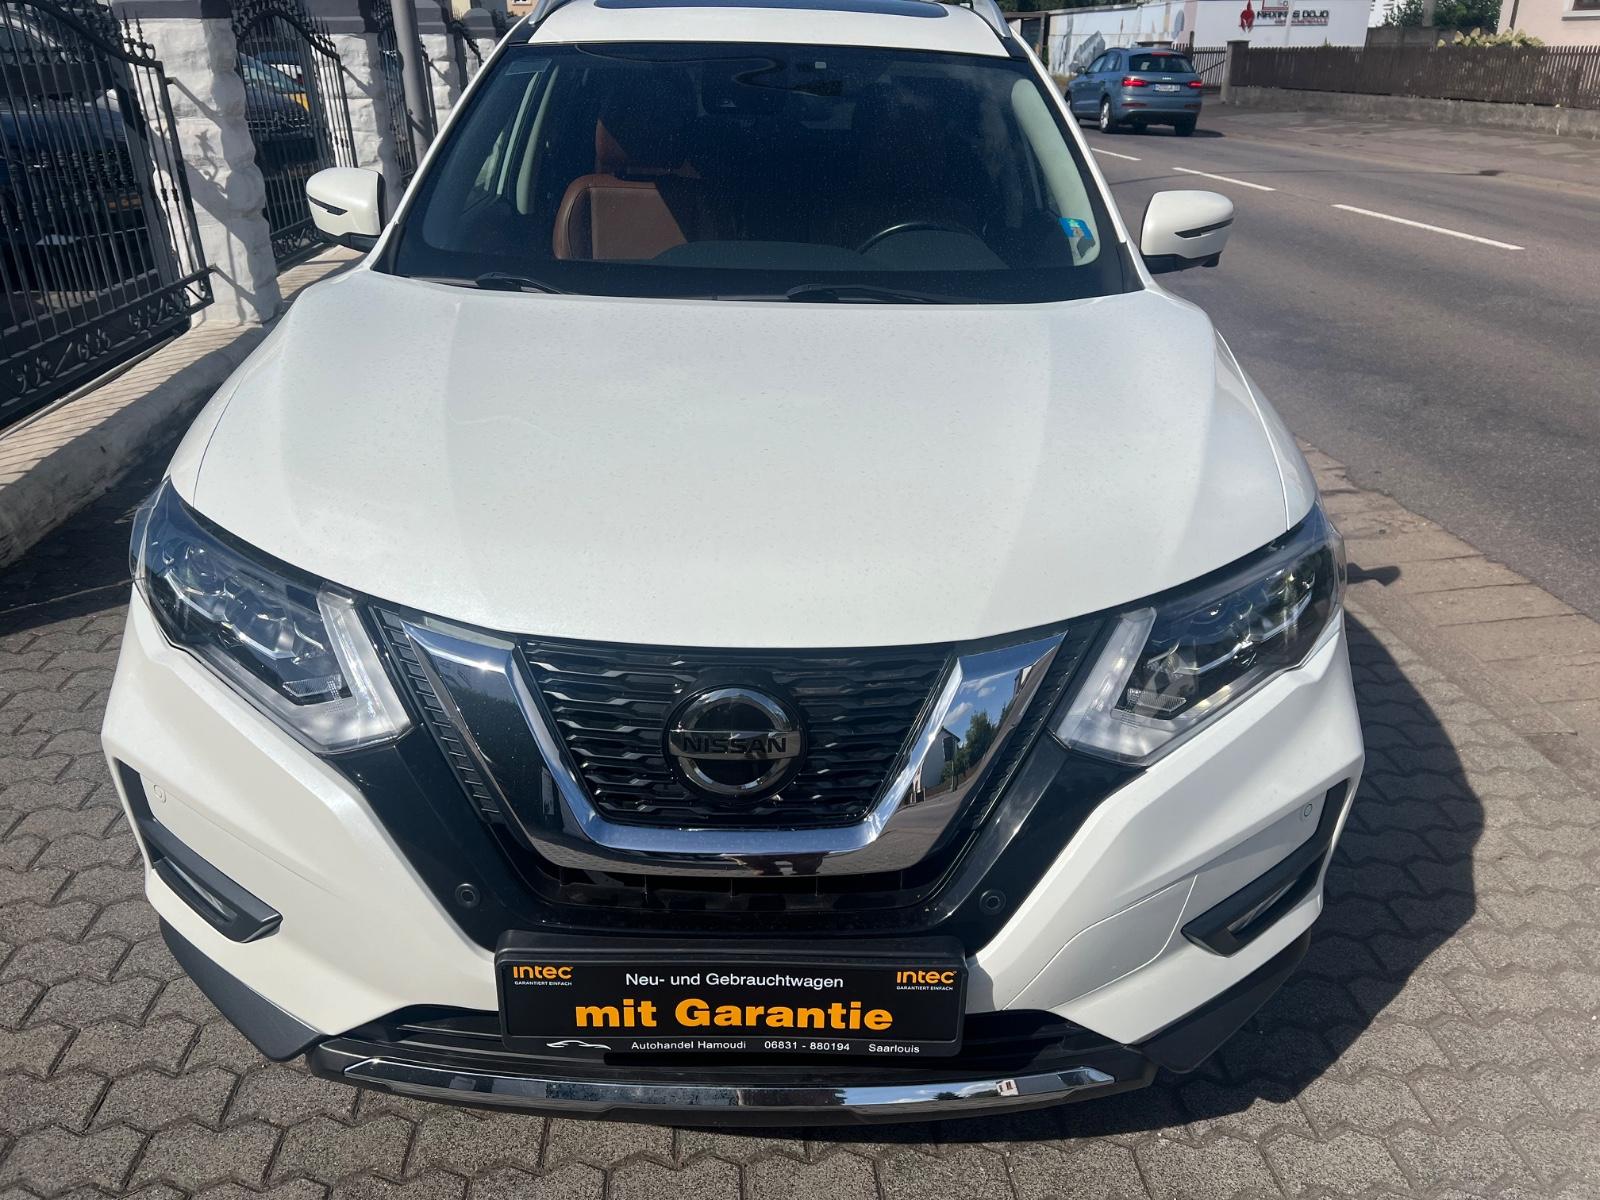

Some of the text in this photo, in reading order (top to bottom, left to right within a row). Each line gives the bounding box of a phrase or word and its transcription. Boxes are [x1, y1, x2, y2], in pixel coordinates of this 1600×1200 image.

[683, 737, 787, 754] NISSAN
[512, 965, 573, 980] intec
[896, 970, 955, 984] intec
[625, 972, 844, 991] Neu- und Gebrauchtwagen
[575, 997, 893, 1031] mit Garantie
[631, 1040, 694, 1050] Autohandel
[697, 1040, 746, 1050] Hamoudi
[764, 1040, 797, 1050] 06831
[809, 1041, 850, 1051] 880194
[868, 1043, 920, 1053] Saarlouis
